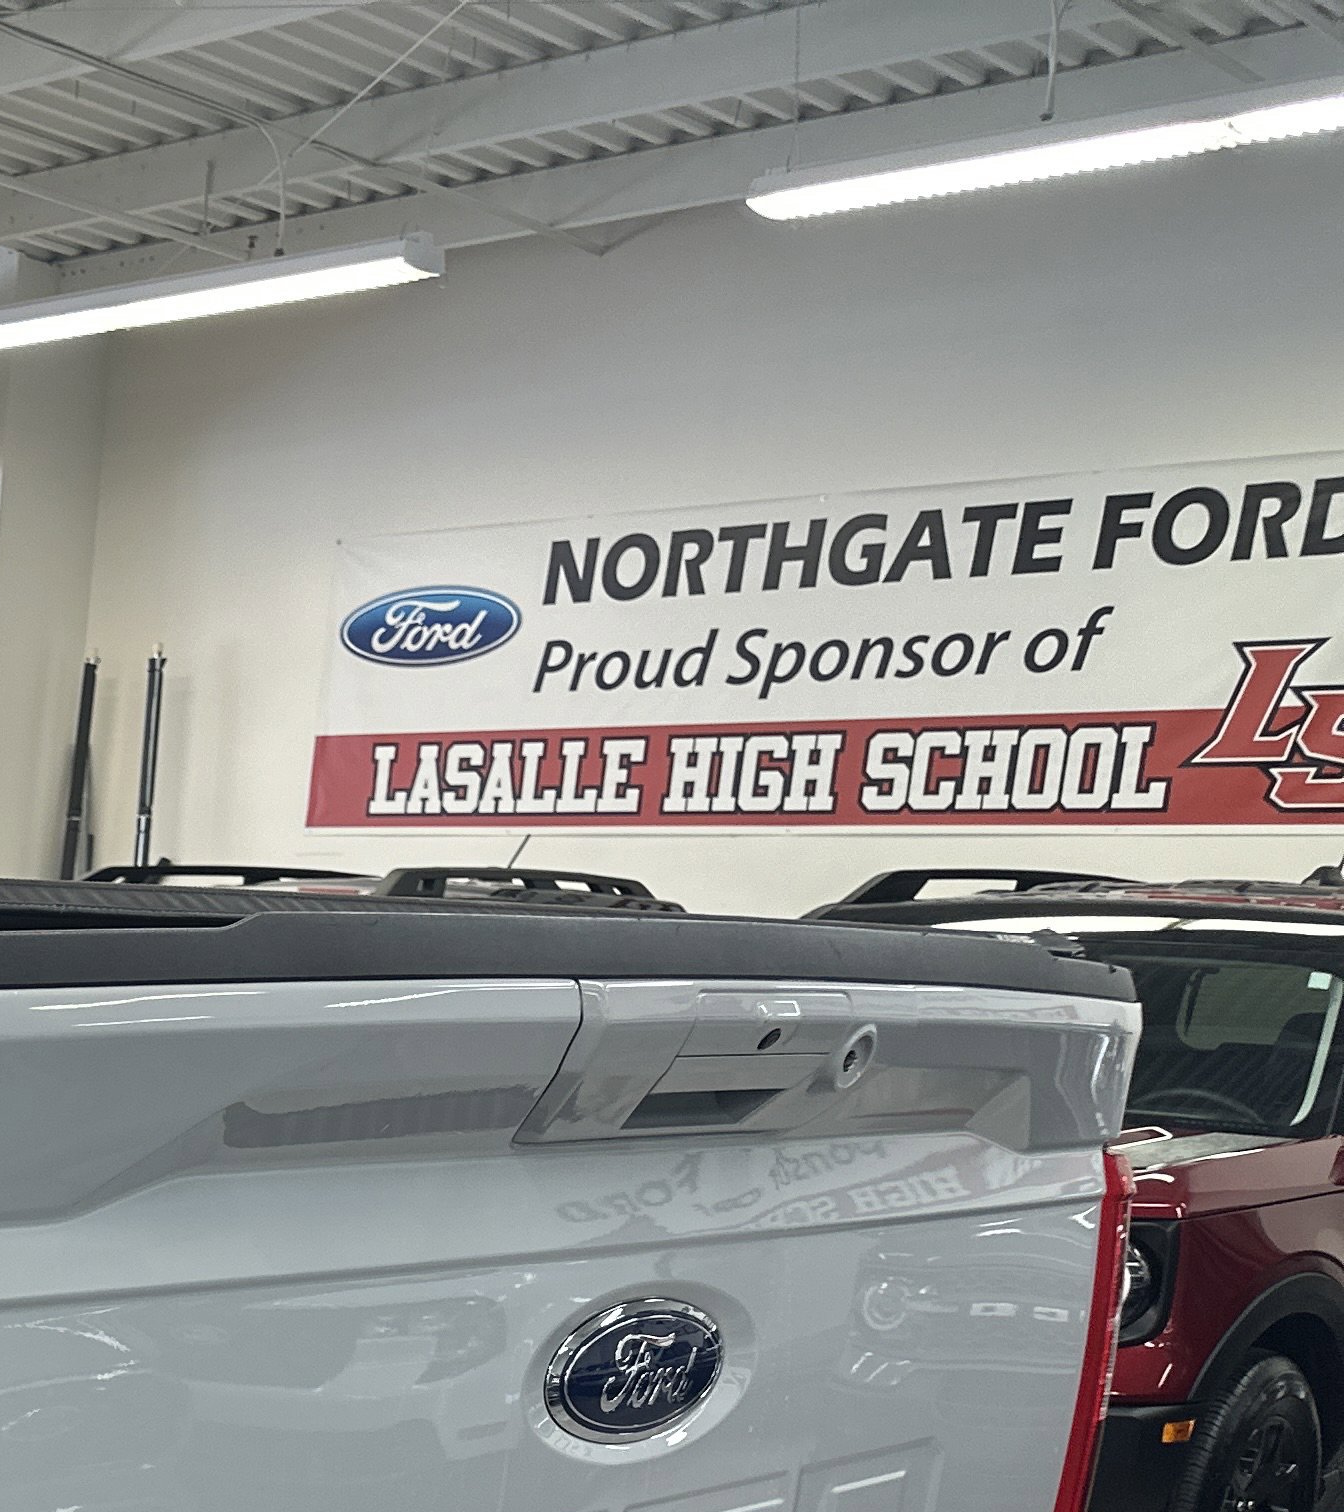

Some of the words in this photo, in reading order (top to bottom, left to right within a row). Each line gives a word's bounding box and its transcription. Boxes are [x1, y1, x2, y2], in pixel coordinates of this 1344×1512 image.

[542, 497, 1073, 606] NORTHGATE
[1091, 476, 1344, 572] FORD
[369, 598, 488, 654] Ford
[531, 627, 720, 694] Proud
[724, 628, 1012, 700] Sponsor
[1022, 604, 1115, 674] of
[366, 734, 650, 818] LASALLE
[658, 728, 848, 816] HIGH
[858, 719, 1173, 815] SCHOOL
[599, 1332, 698, 1413] Ford
